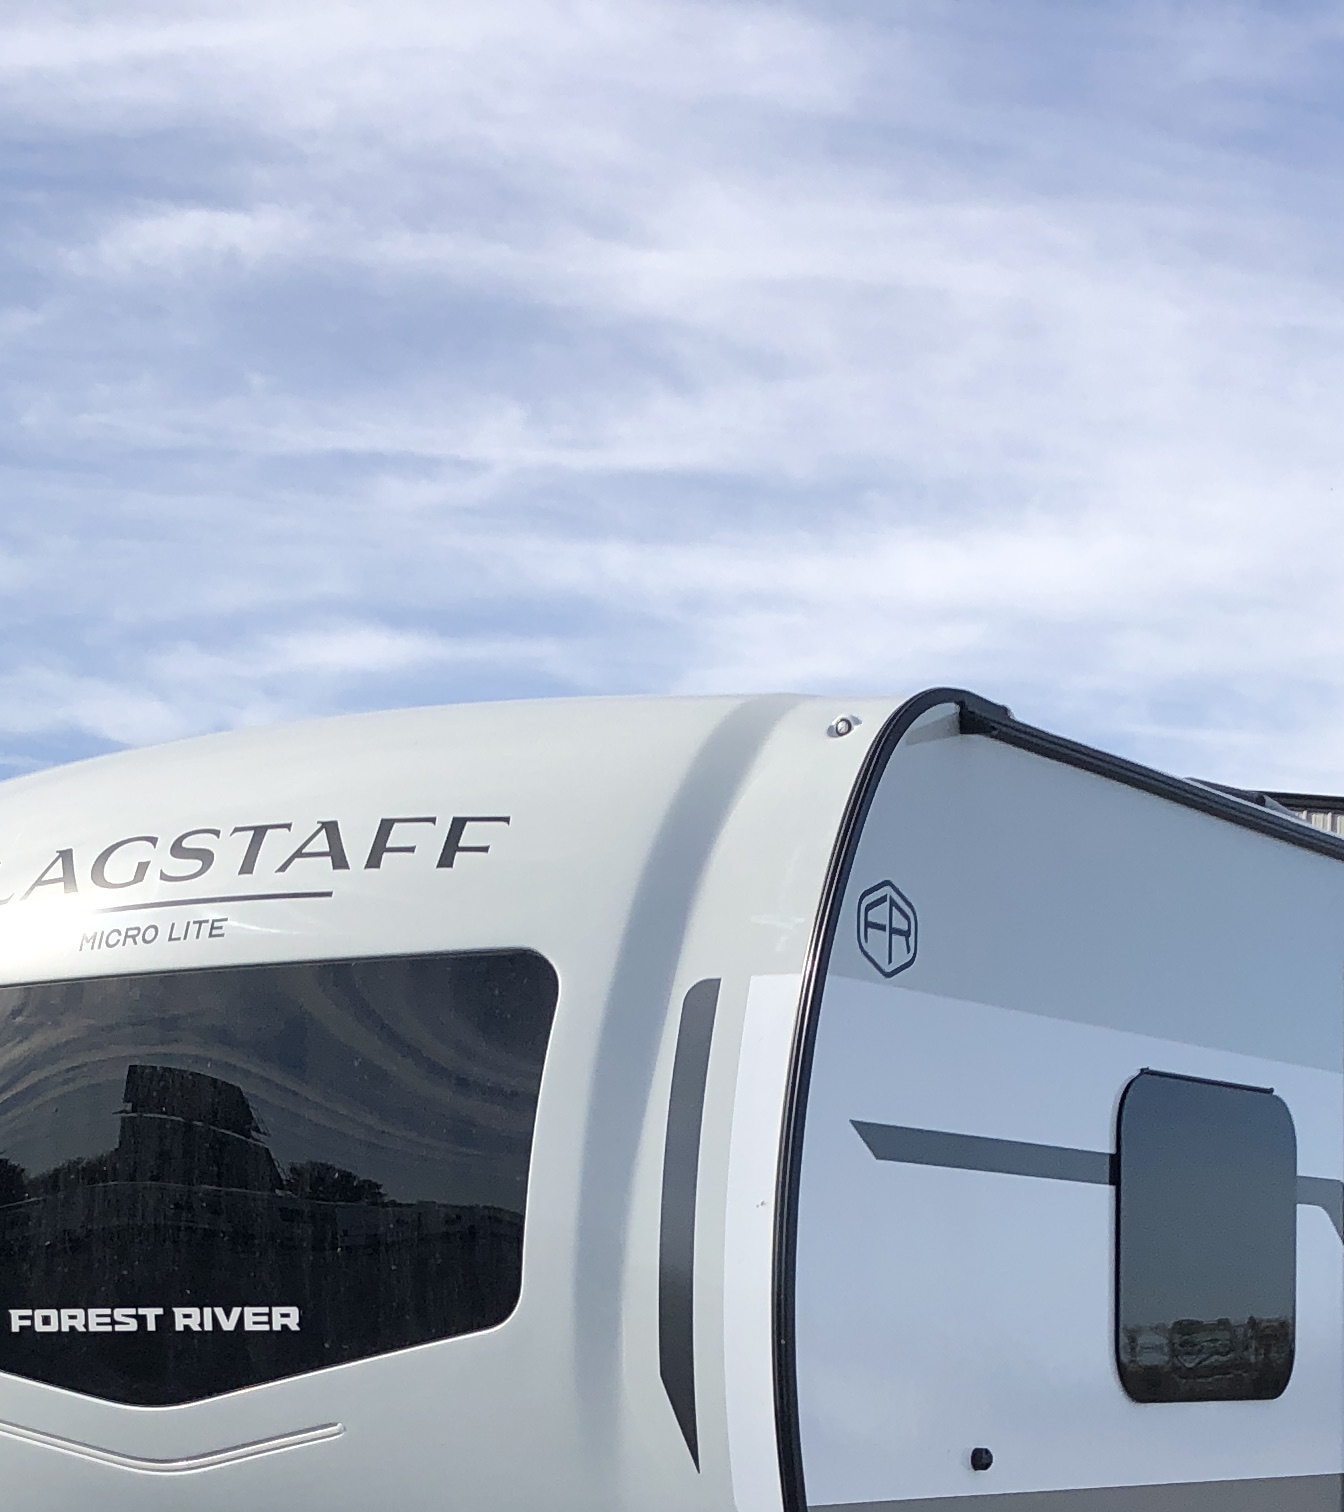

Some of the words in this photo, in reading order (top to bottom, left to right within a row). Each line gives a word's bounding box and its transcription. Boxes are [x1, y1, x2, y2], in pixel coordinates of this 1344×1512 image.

[79, 924, 159, 952] MICRO
[167, 917, 229, 942] LITE
[8, 1307, 164, 1333] FOREST
[171, 1306, 302, 1332] RIVER
